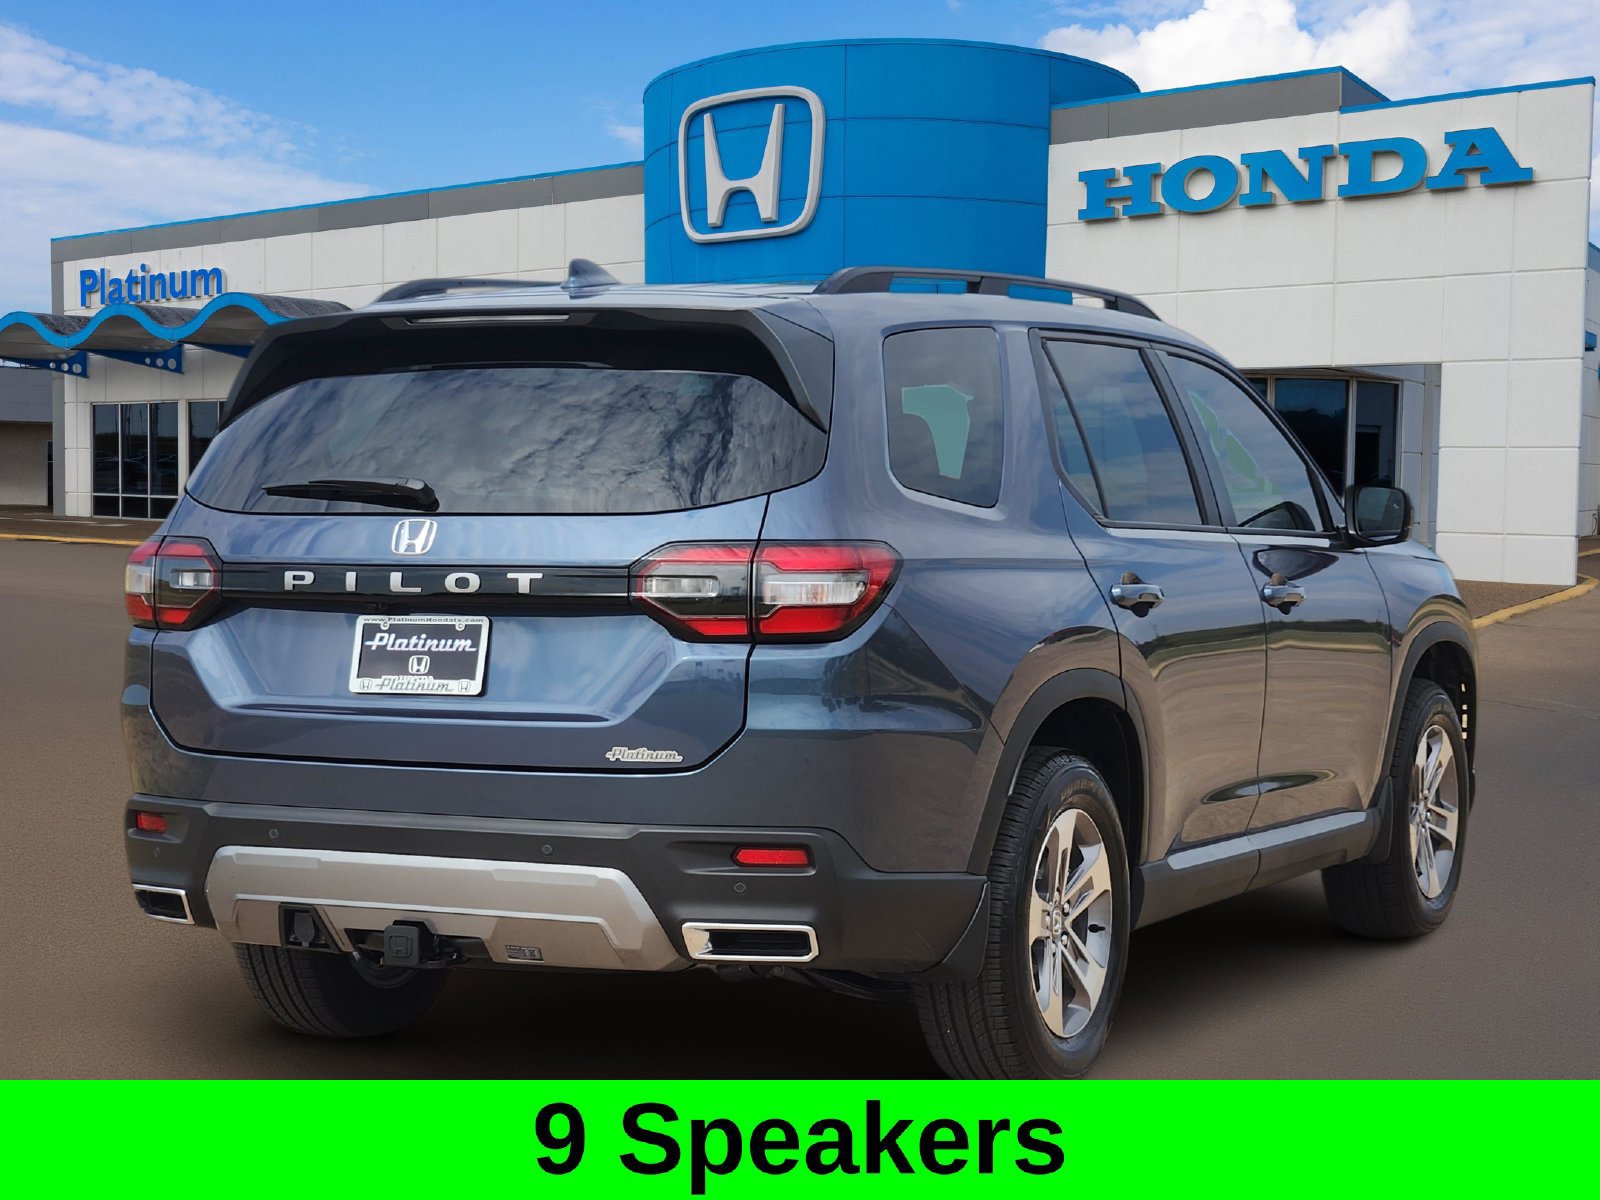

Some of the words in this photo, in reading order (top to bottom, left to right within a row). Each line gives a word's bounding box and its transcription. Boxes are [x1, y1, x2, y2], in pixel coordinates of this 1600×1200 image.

[1078, 126, 1535, 222] HONDA
[79, 262, 225, 308] Platinum
[283, 570, 544, 595] PILOT
[364, 632, 477, 652] Platinum
[375, 677, 454, 692] Platinum
[605, 746, 683, 762] Platinum
